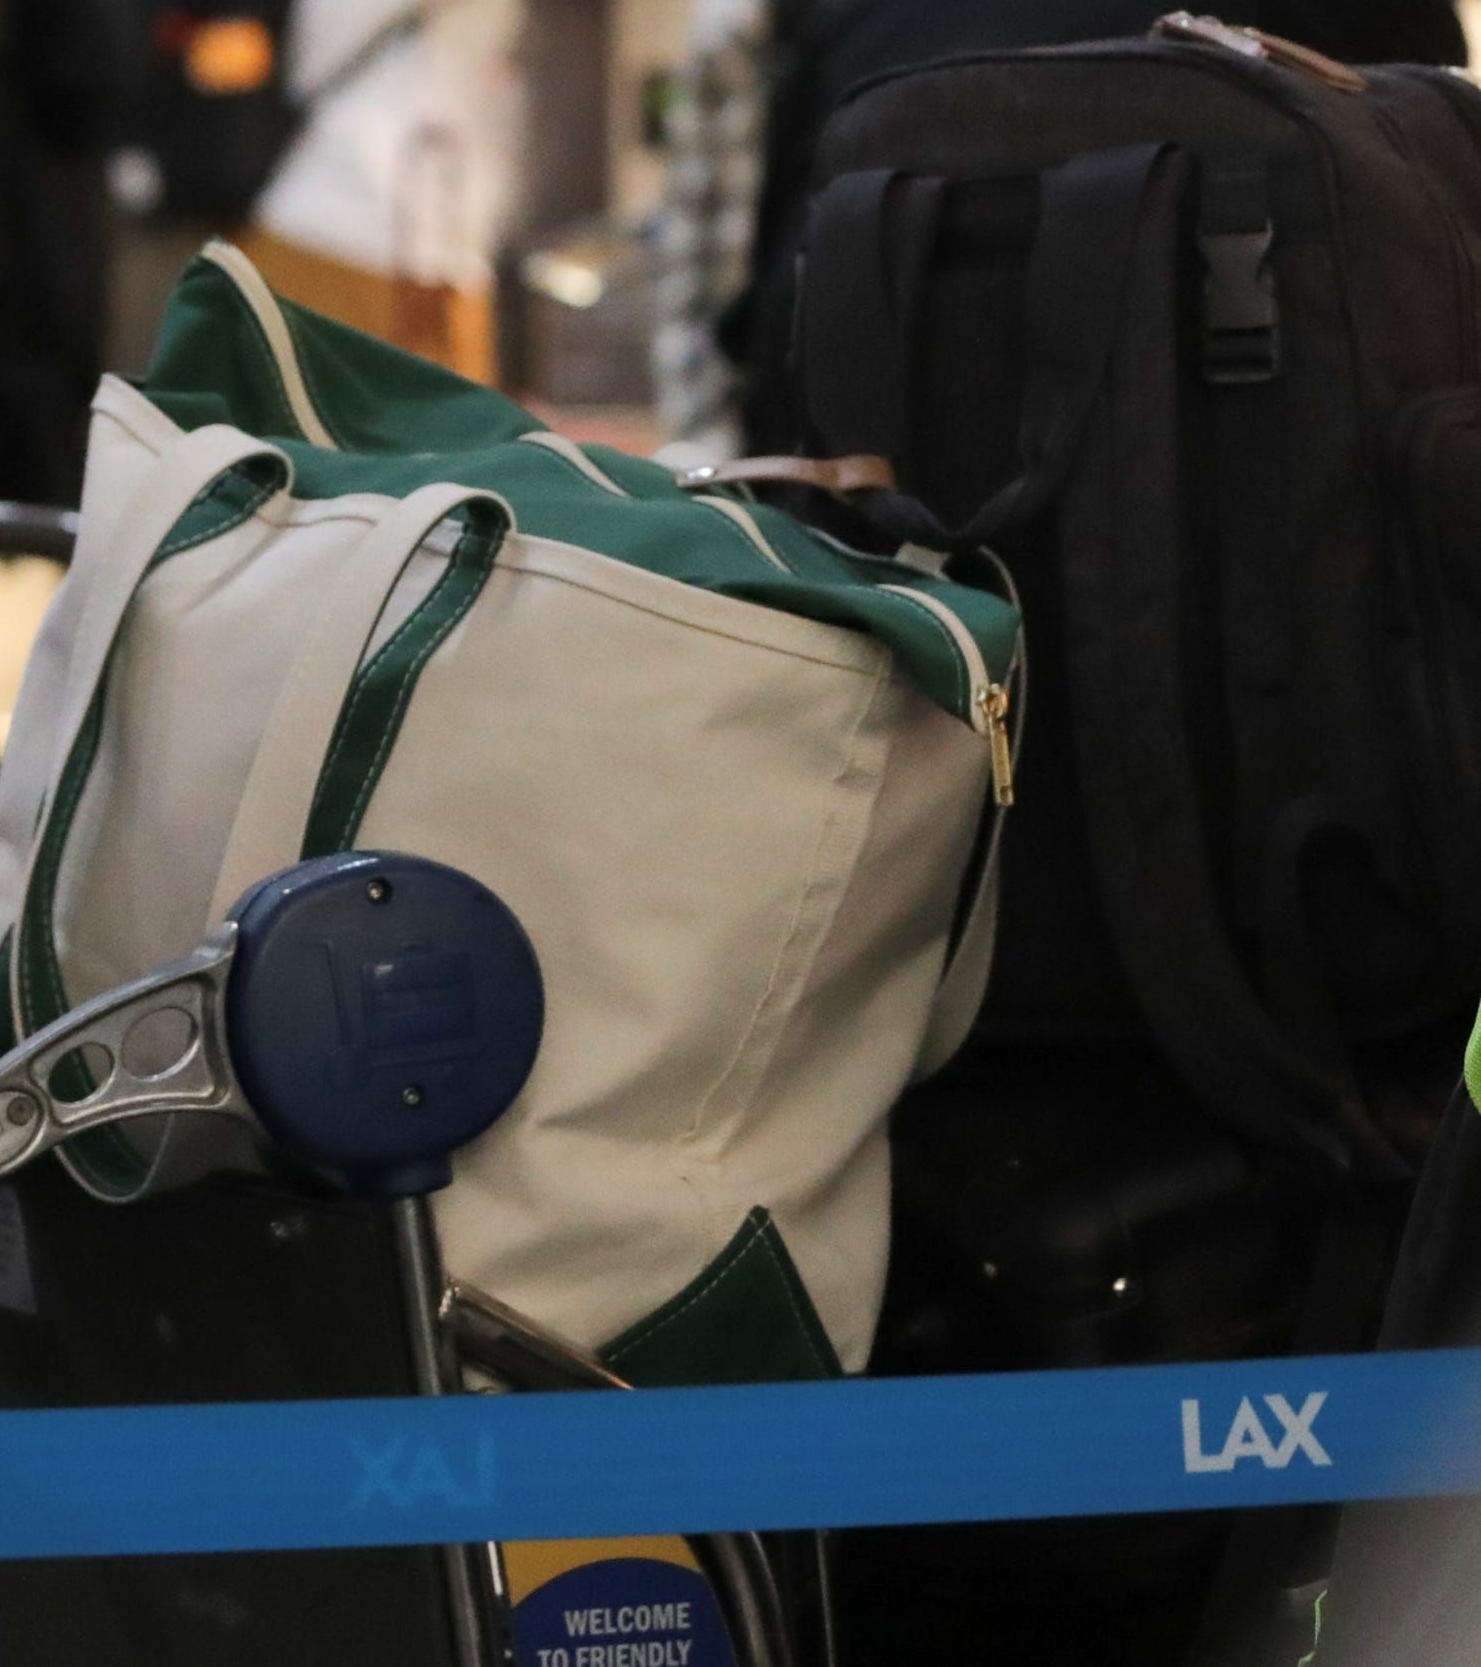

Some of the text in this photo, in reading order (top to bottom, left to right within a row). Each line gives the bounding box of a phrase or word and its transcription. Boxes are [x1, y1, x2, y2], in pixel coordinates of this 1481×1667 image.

[1182, 1393, 1331, 1472] LAX
[564, 1602, 692, 1637] WELCOME
[537, 1639, 692, 1667] TO FRIENDLY
